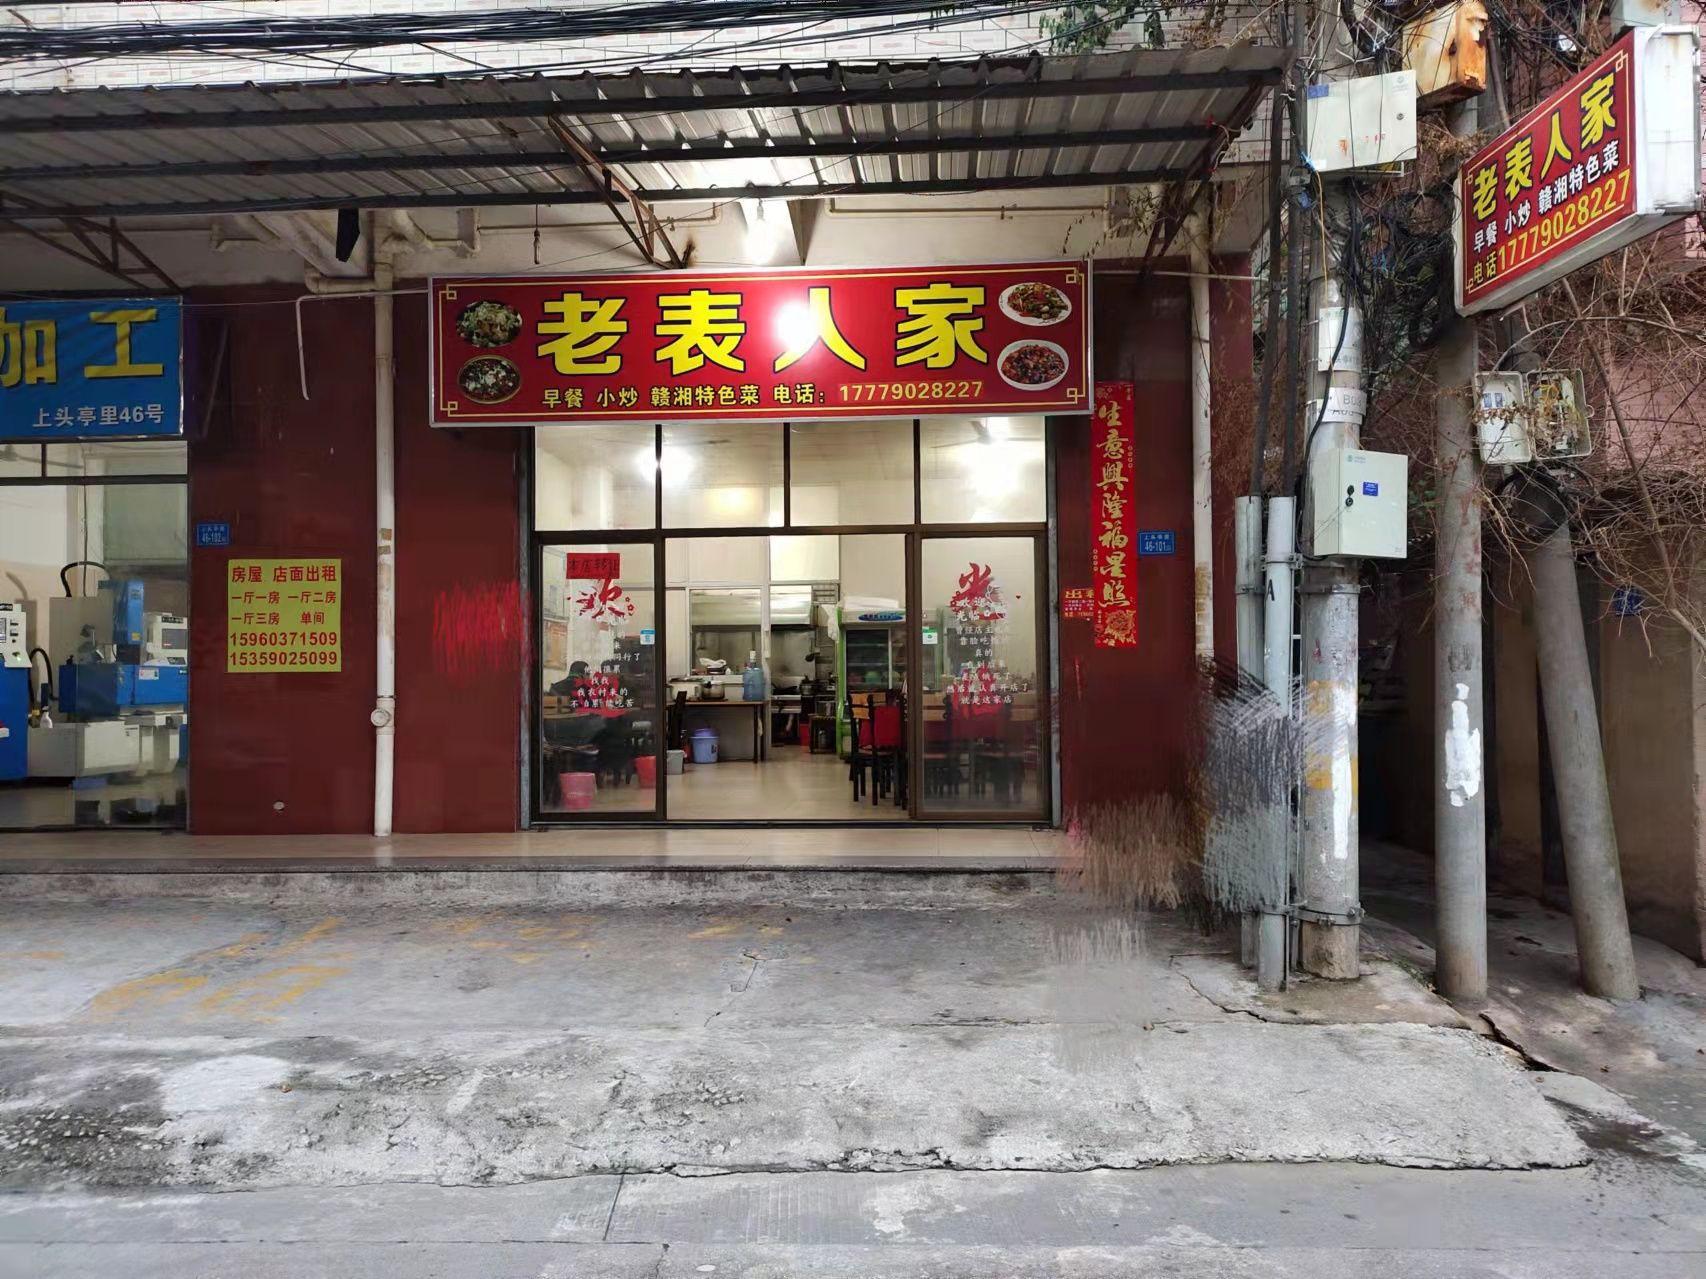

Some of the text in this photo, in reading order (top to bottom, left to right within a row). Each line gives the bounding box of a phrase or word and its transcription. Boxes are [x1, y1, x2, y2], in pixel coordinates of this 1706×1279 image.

[1472, 69, 1617, 222] 老表人家
[1473, 139, 1620, 254] 早餐 小炒 赣湘特色菜
[1473, 168, 1631, 283] 电话 17779028227
[537, 283, 989, 376] 老表人家
[0, 306, 164, 388] 加工
[542, 387, 583, 408] 早餐
[596, 386, 638, 408] 小炒
[650, 384, 760, 407] 赣湘特色菜
[839, 380, 984, 402] 17779028227
[32, 403, 165, 429] 上头亭里46号
[231, 565, 337, 583] 房屋 店面出租
[231, 591, 337, 604] 一厅一房 一厅二房
[231, 611, 325, 625] 一厅三房 单间
[230, 632, 337, 647] 15960371509
[230, 651, 337, 666] 15359025099
